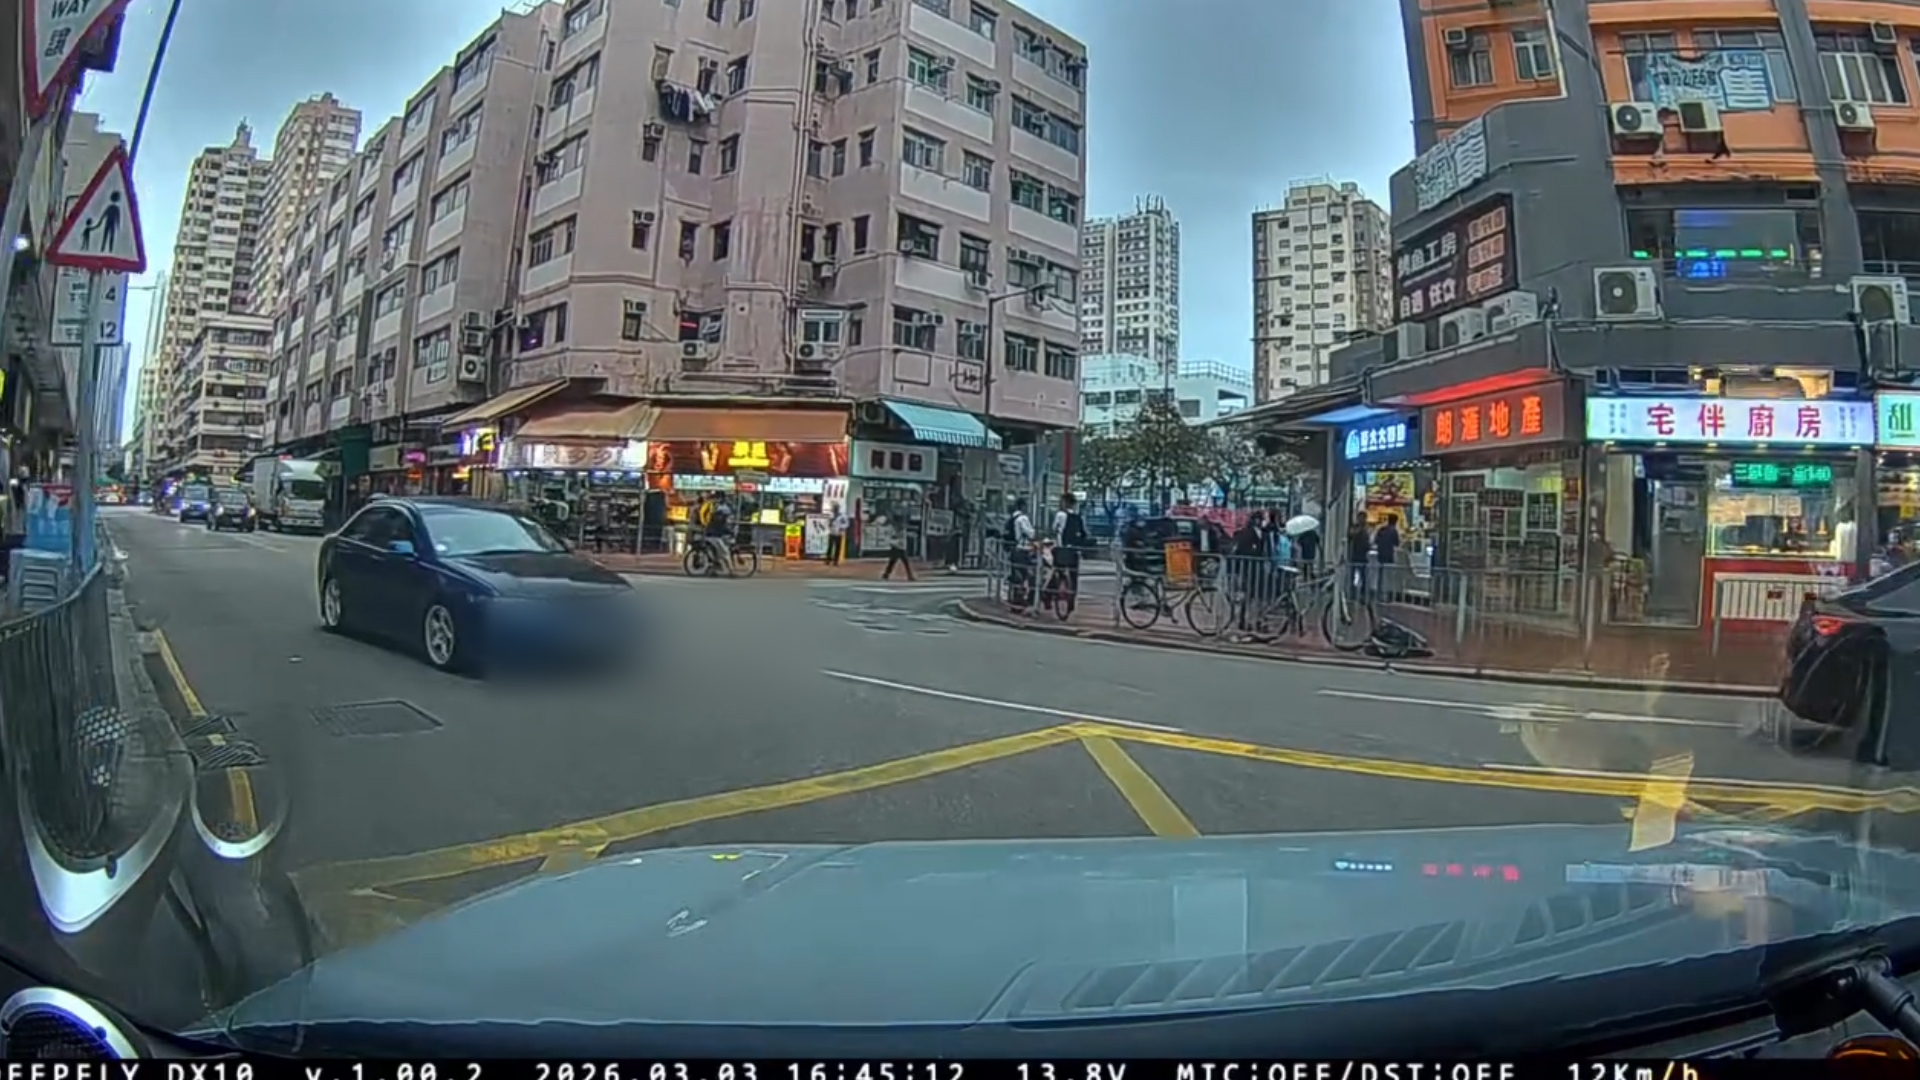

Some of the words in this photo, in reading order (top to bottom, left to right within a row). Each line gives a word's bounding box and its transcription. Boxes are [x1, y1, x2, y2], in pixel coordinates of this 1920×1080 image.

[51, 0, 88, 19] WAY
[101, 321, 117, 339] 12
[1646, 402, 1822, 438] 宅伴廚房
